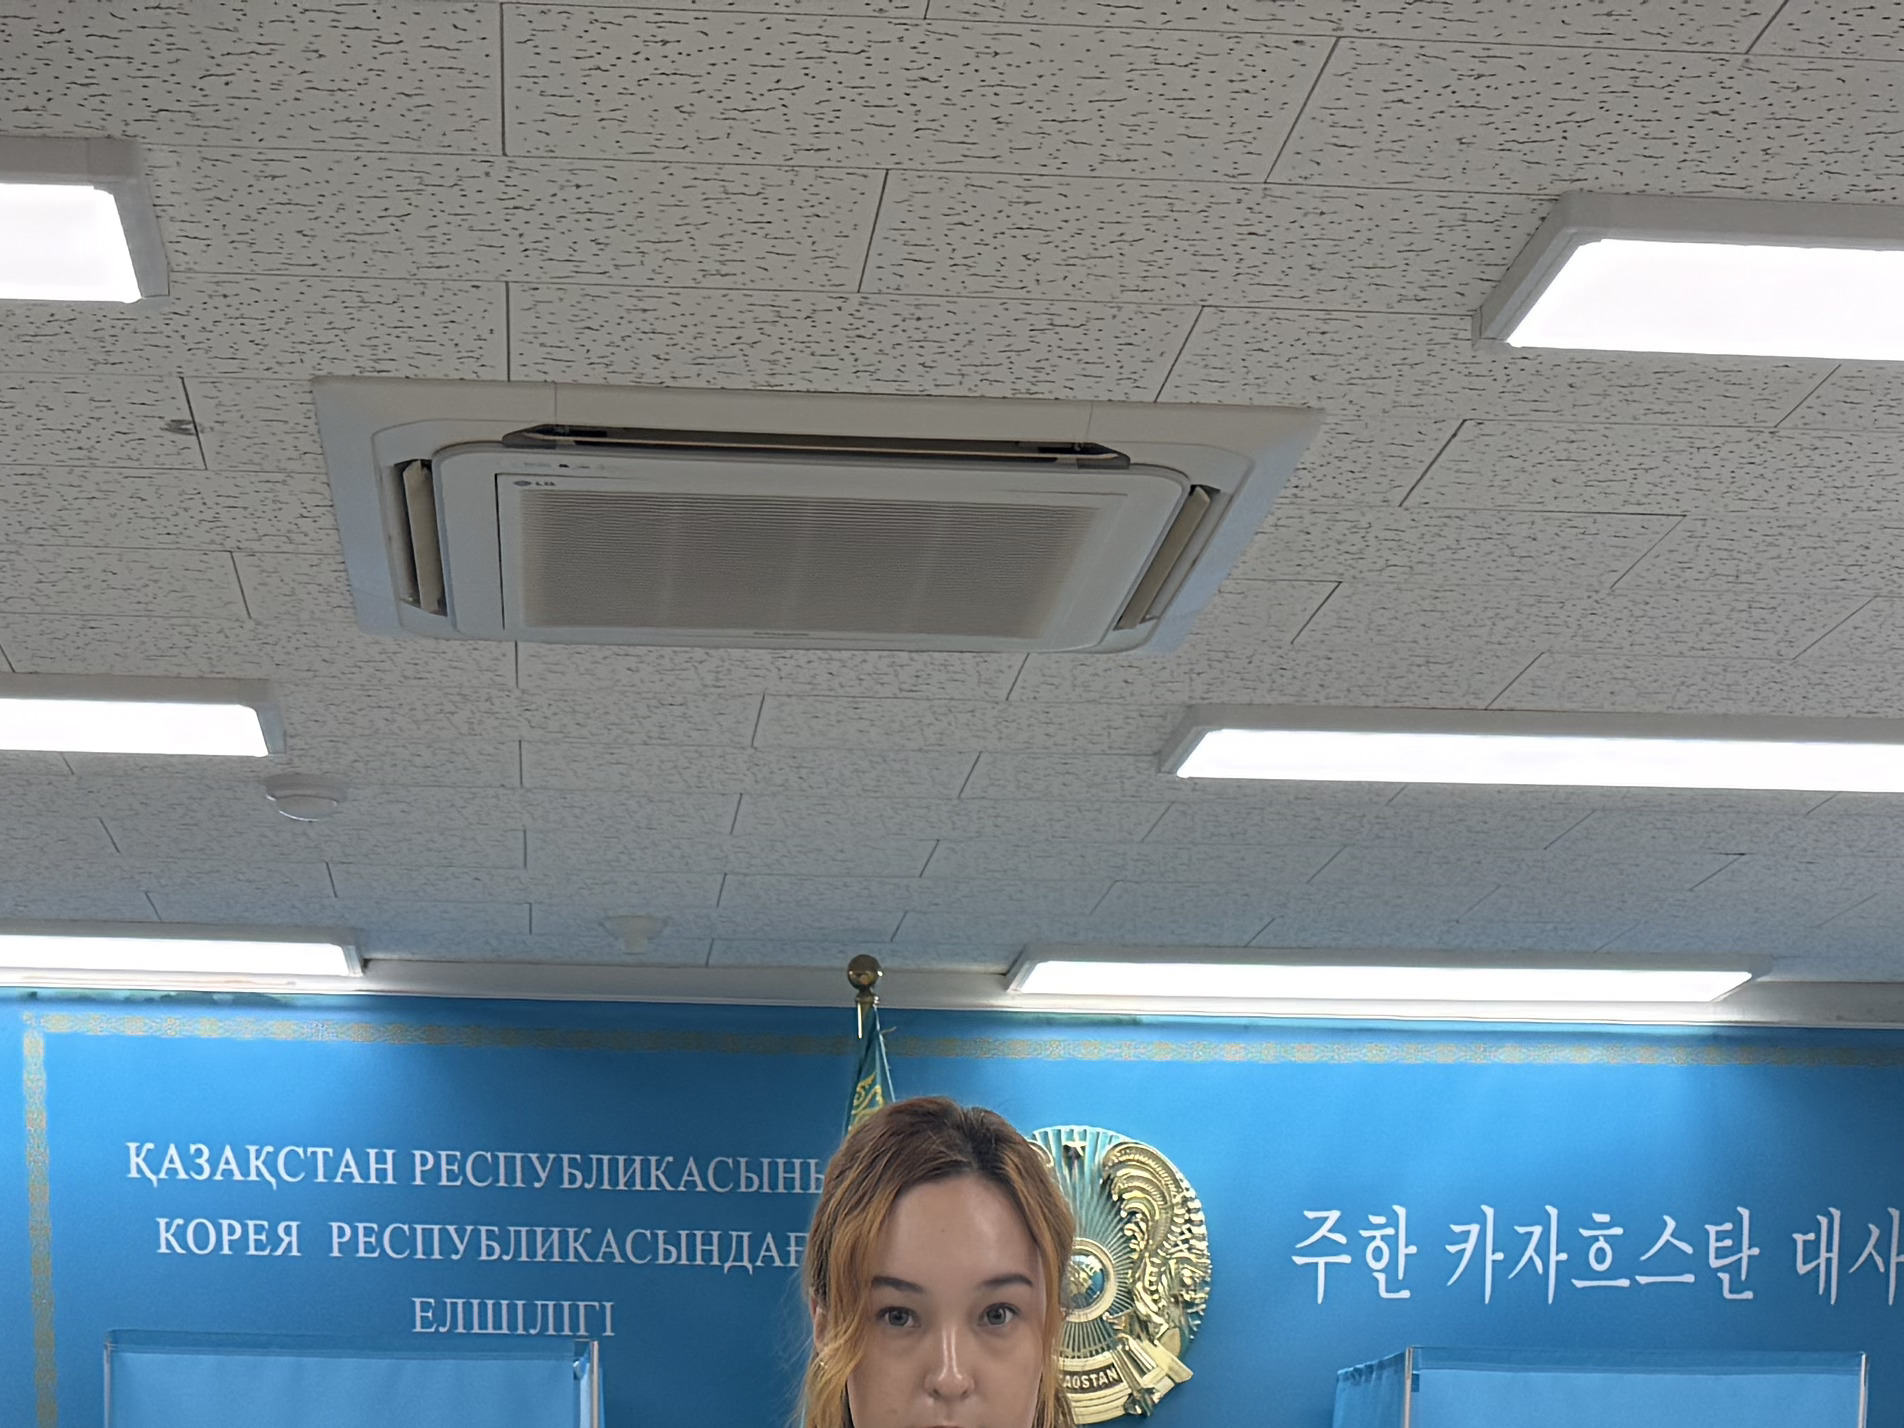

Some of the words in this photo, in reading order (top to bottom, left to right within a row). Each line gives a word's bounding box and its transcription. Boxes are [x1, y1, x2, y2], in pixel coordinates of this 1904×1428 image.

[125, 1141, 396, 1192] ҚАЗАҚСТАН
[412, 1149, 824, 1195] РЕСПУБЛИКАСЫН
[155, 1216, 301, 1257] КОРЕЯ
[329, 1221, 809, 1275] РЕСПУБЛИКАСЫНДАҒ
[1291, 1203, 1417, 1306] 주한
[1444, 1203, 1761, 1306] 카자흐스탄
[411, 1295, 616, 1338] ЕЛШІЛІГІ
[1063, 1366, 1120, 1389] AQSTAN
